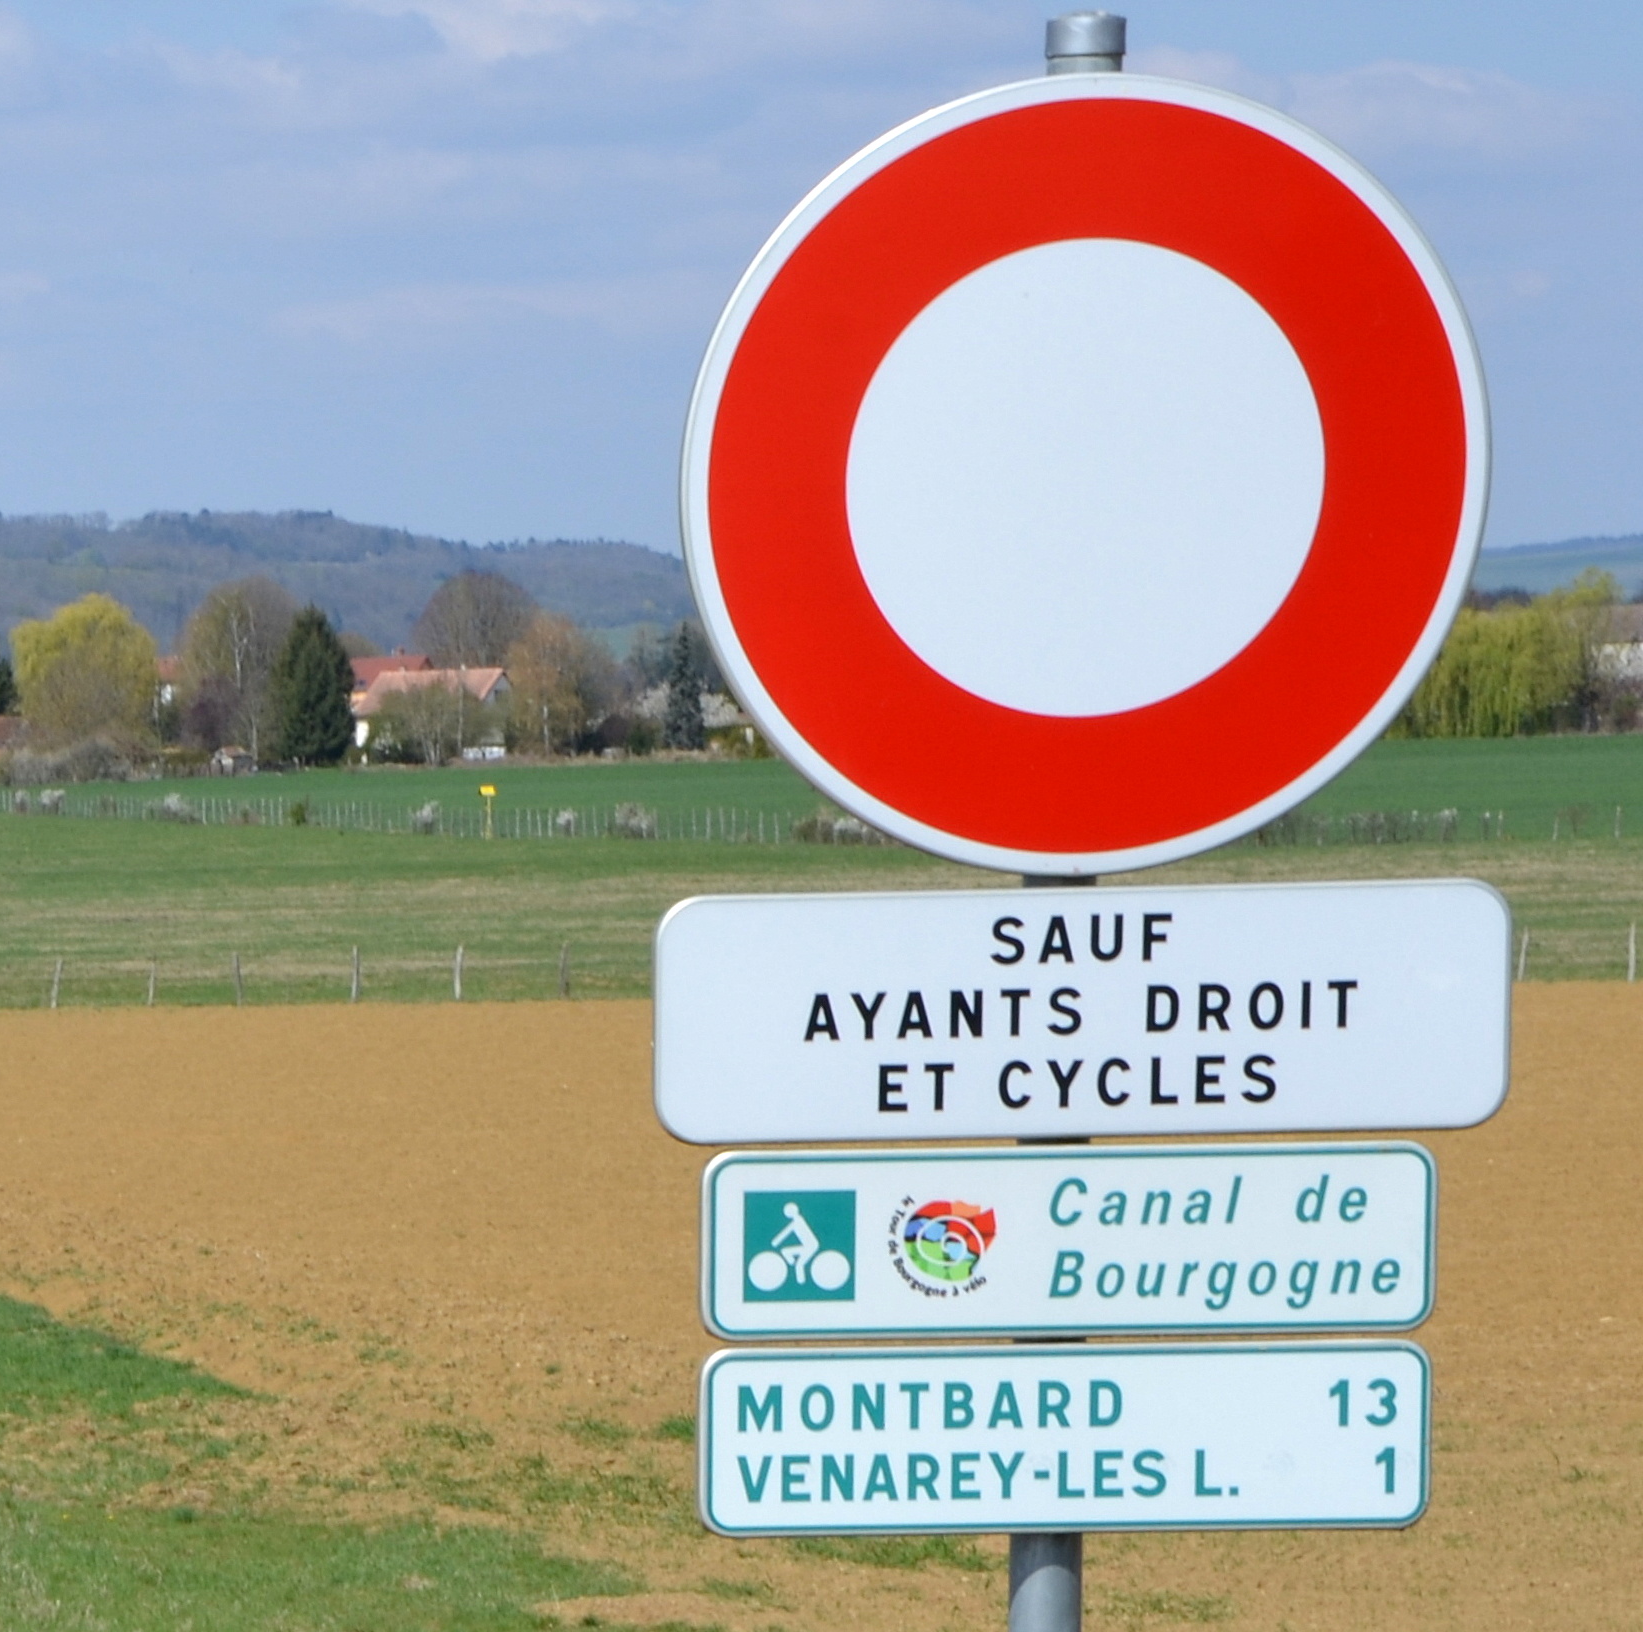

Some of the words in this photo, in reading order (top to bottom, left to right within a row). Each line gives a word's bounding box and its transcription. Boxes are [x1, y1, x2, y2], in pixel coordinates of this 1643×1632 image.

[990, 912, 1173, 966] SAUF
[803, 986, 1082, 1042] AYANTS
[1145, 979, 1358, 1033] DROIT
[877, 1062, 955, 1113] ET
[998, 1053, 1277, 1110] CYCLES
[1049, 1175, 1243, 1227] Canal
[1295, 1173, 1368, 1223] de
[893, 1257, 948, 1297] Bourgogne
[1048, 1249, 1401, 1311] Bourgogne
[737, 1379, 1123, 1433] MONTBARD
[1329, 1377, 1398, 1427] 13
[737, 1449, 1167, 1503] VENAREY-LES
[1194, 1448, 1240, 1497] L.
[1375, 1446, 1396, 1495] 1
